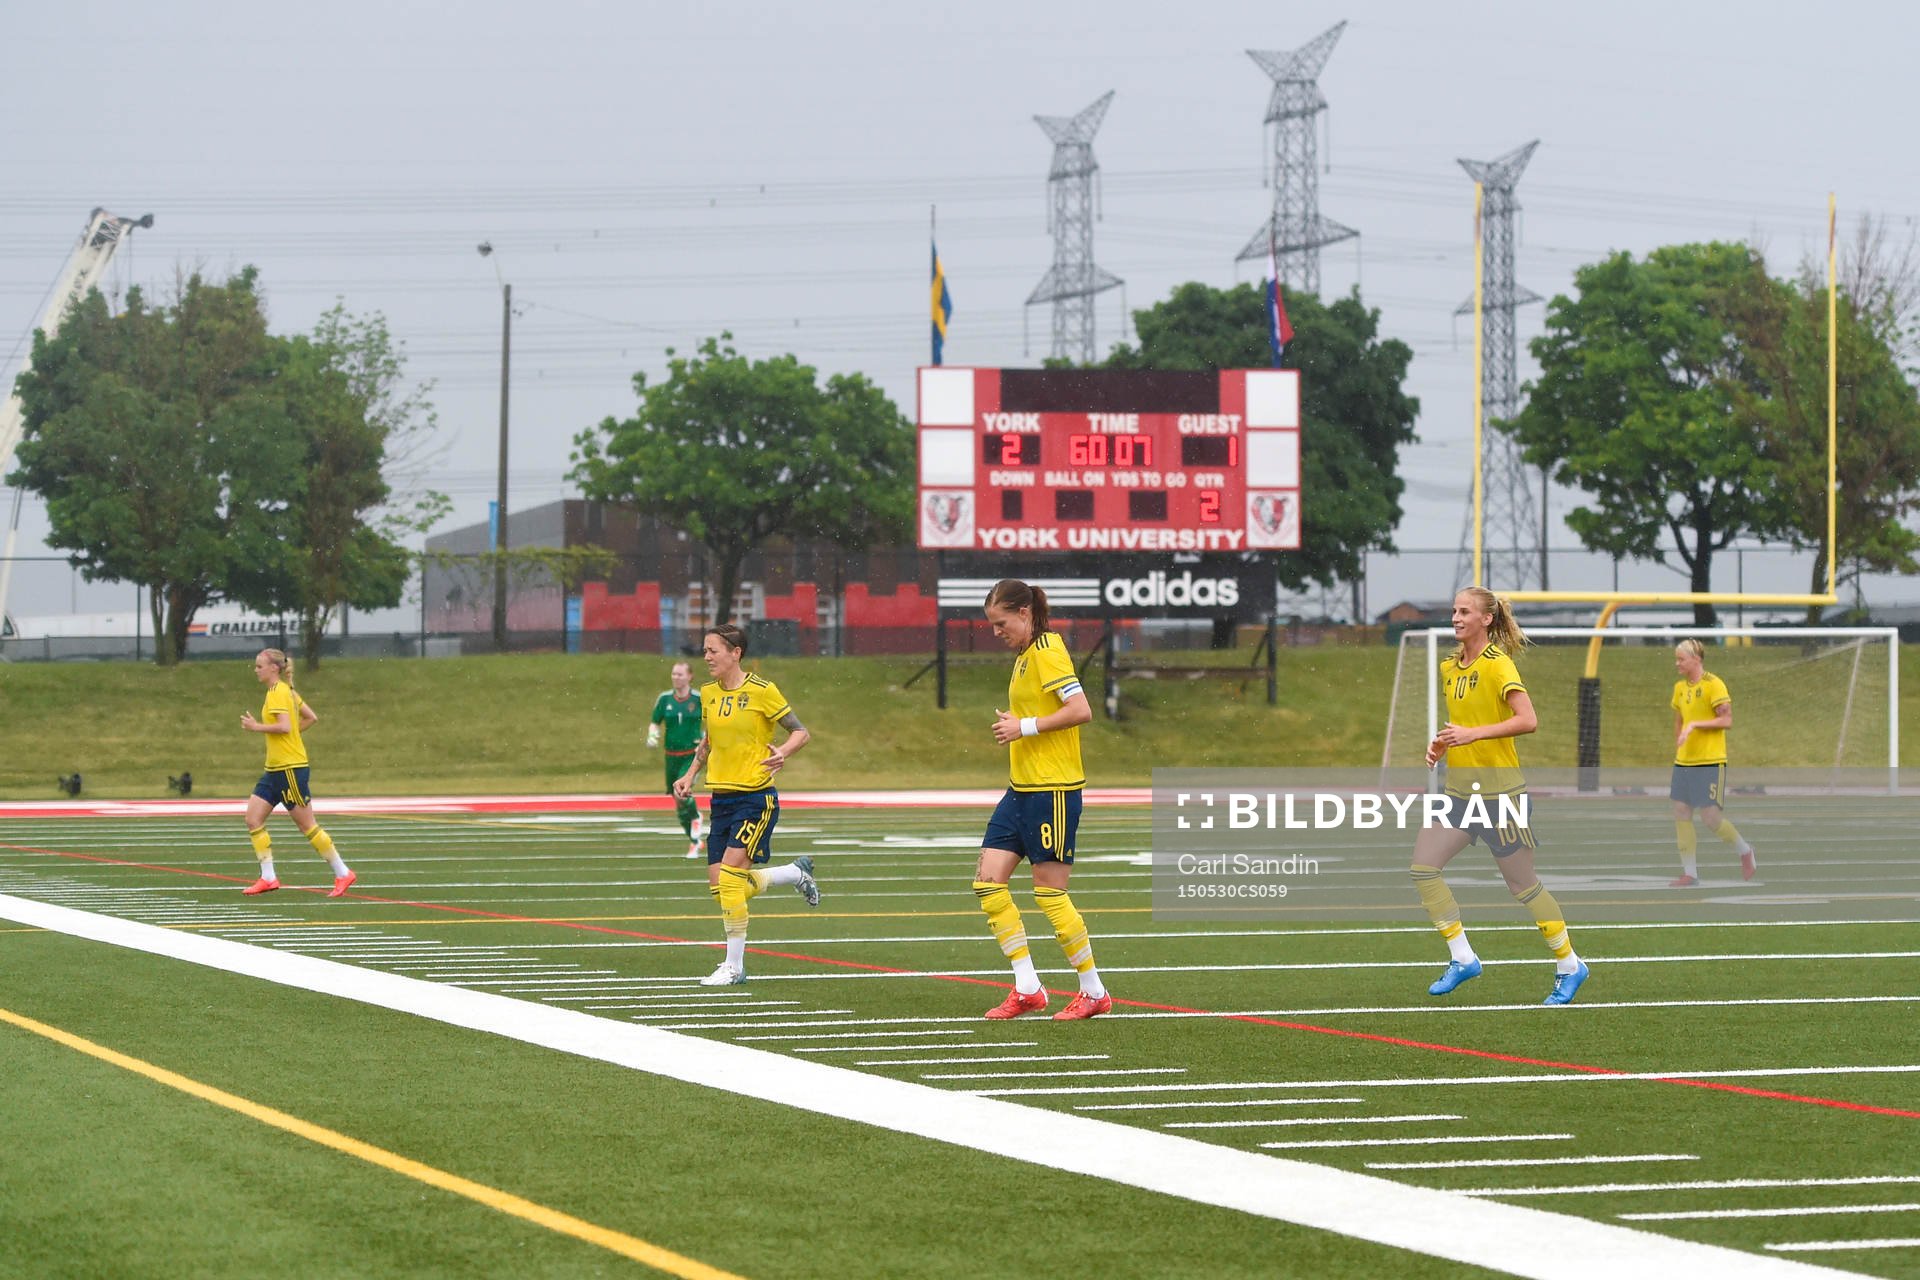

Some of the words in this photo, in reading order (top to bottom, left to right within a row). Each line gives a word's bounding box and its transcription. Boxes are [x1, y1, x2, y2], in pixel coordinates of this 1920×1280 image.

[982, 413, 1041, 432] YORK
[1087, 413, 1139, 433] TIME
[1178, 414, 1241, 434] GUEST
[1001, 434, 1022, 465] 2
[1228, 435, 1239, 467] 1
[990, 471, 1035, 487] DOWN
[1044, 471, 1080, 487] BALL
[1083, 471, 1105, 487] ON
[1112, 472, 1139, 487] YDS
[1143, 472, 1162, 488] TO
[1165, 472, 1187, 488] GO
[1194, 473, 1225, 488] QTR
[1200, 491, 1221, 522] 2
[978, 528, 1059, 548] YORK
[1068, 528, 1244, 549] UNIVERSITY
[1105, 570, 1240, 607] adidas
[211, 620, 304, 636] CHALLENGE
[1454, 675, 1468, 700] 10
[718, 696, 733, 717] 15
[281, 788, 295, 805] 14
[1709, 783, 1717, 800] 5
[735, 819, 755, 845] 15
[1040, 822, 1053, 849] 8
